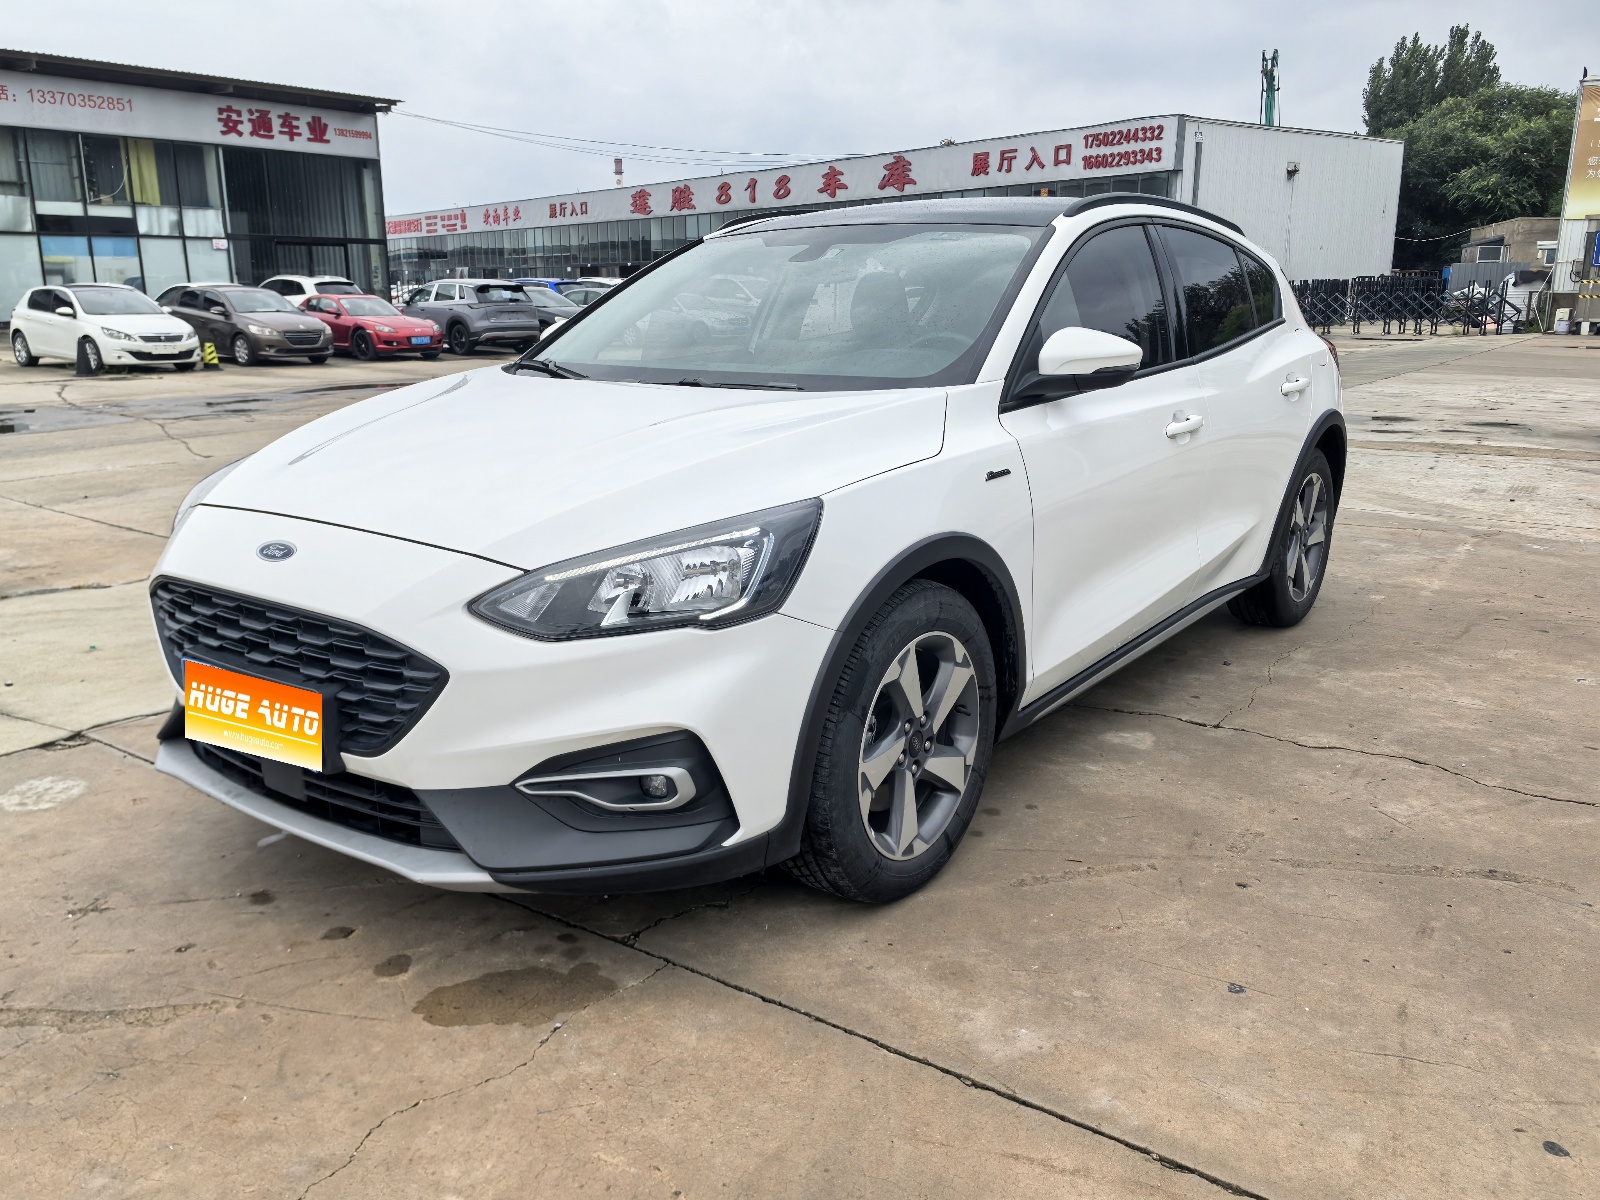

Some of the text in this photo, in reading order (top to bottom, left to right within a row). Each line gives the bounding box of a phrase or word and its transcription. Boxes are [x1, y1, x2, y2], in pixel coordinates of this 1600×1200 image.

[26, 88, 133, 112] 13370352851
[217, 104, 331, 144] 安通车业
[1083, 124, 1165, 149] 17502244332
[970, 143, 1073, 177] 展厅入口
[1081, 146, 1163, 170] 16602293343
[548, 201, 589, 219] 展厅入口
